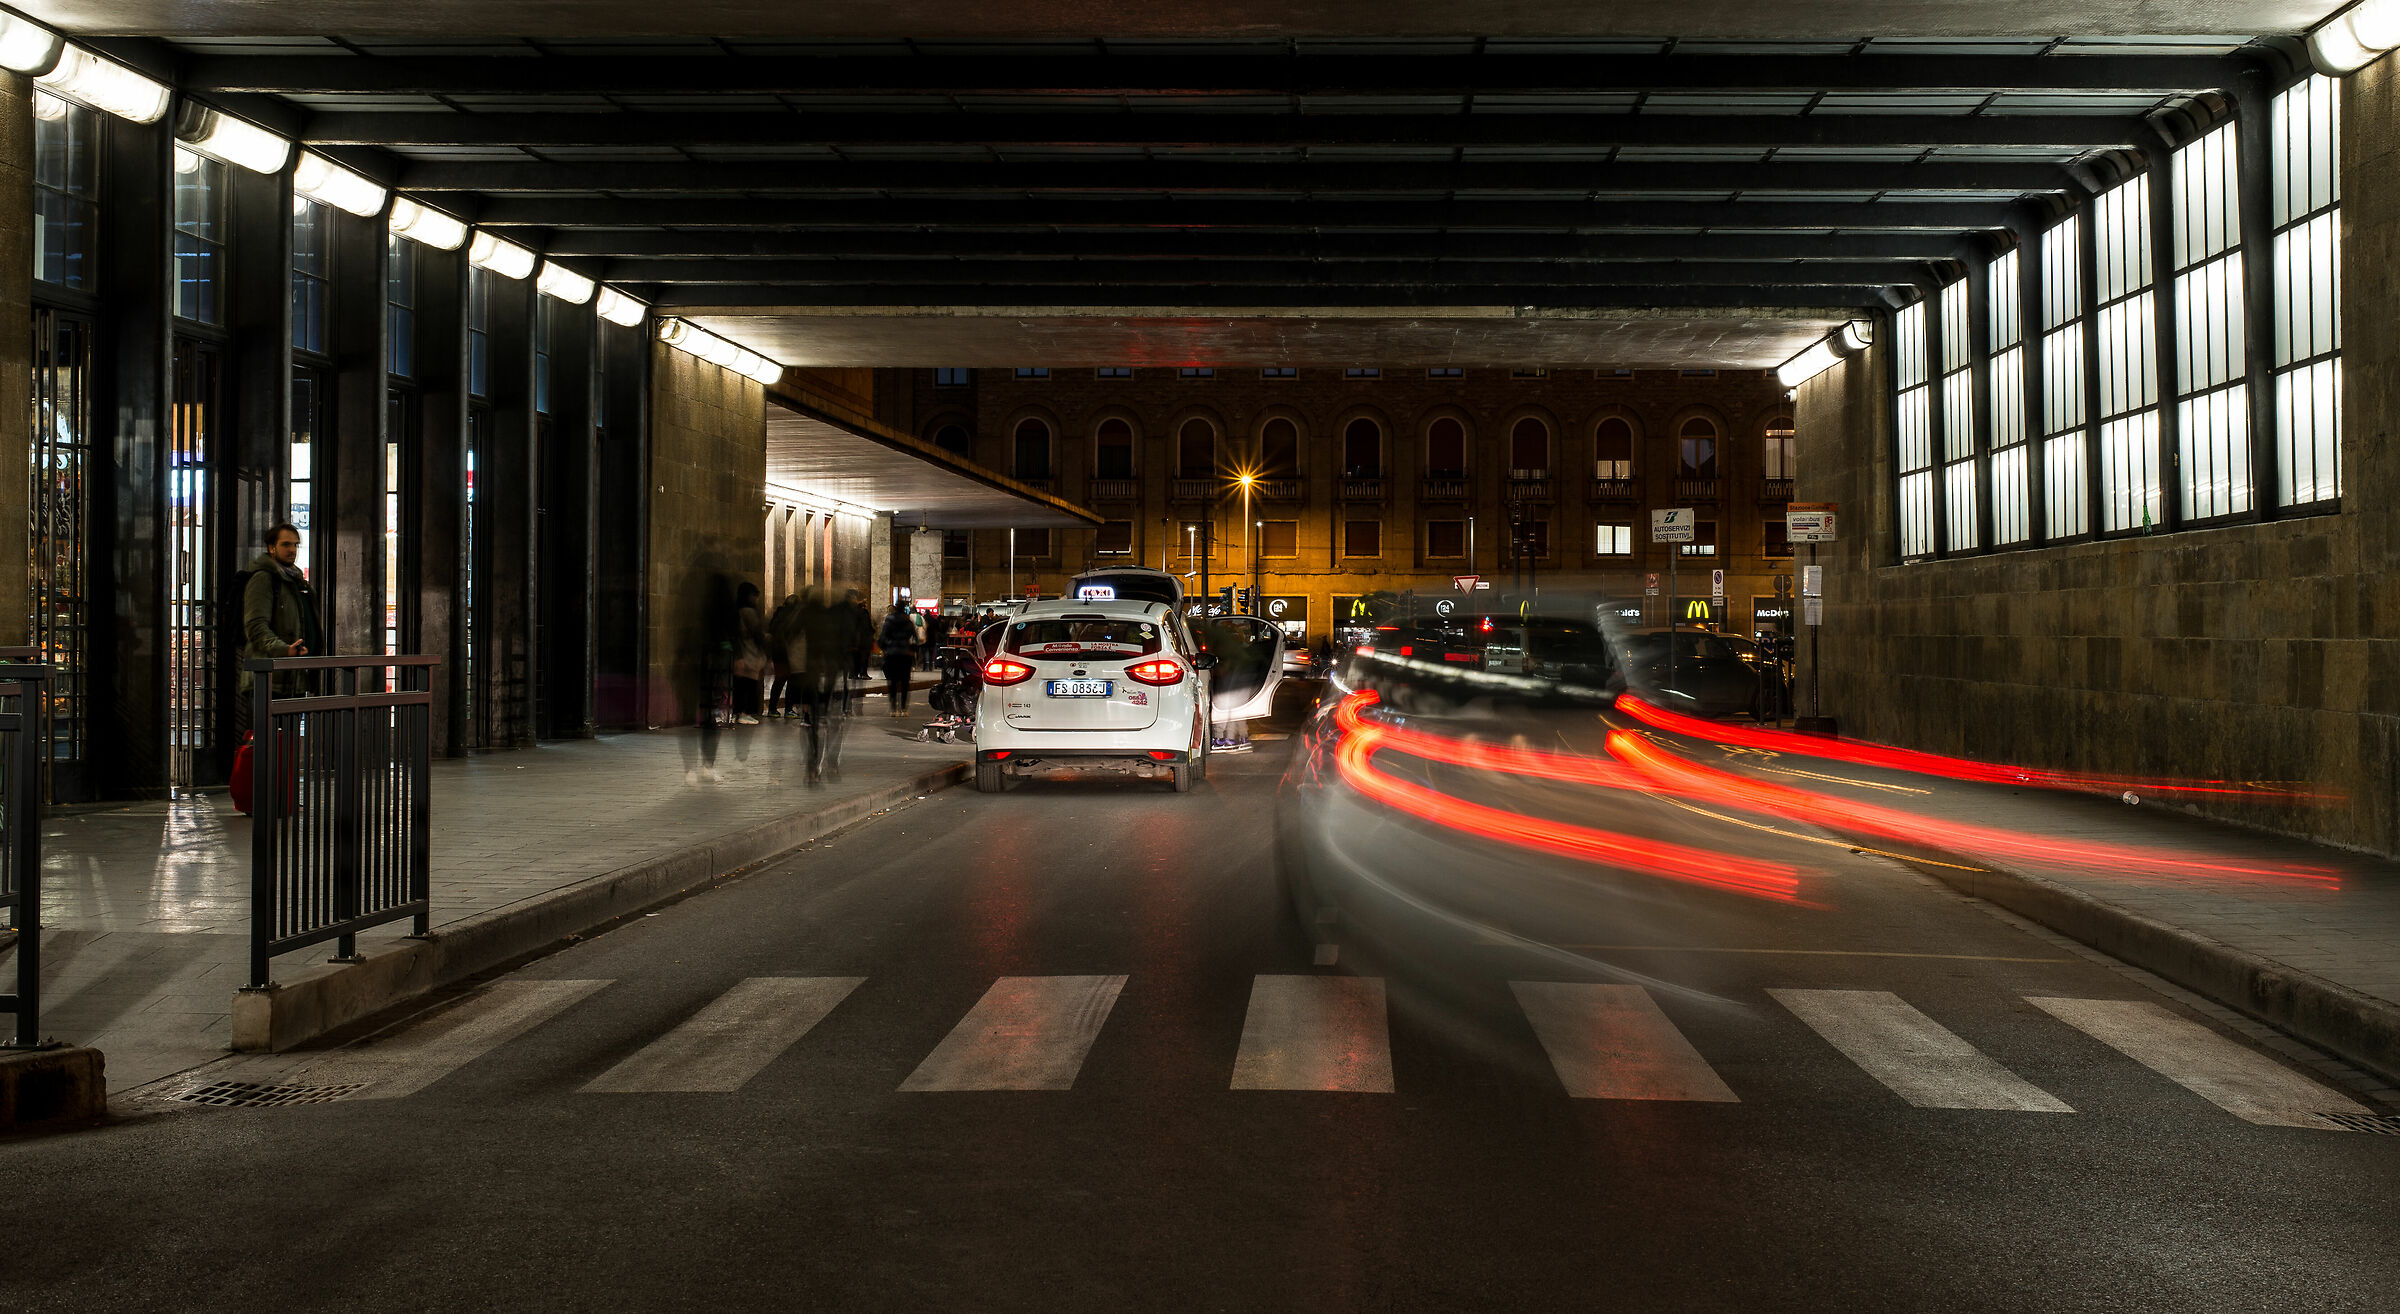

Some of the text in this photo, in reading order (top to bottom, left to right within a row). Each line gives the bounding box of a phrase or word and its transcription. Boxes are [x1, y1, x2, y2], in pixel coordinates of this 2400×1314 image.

[1654, 525, 1690, 533] AUTOSERVIZI
[1083, 589, 1111, 597] TAXI
[1055, 683, 1068, 694] FS
